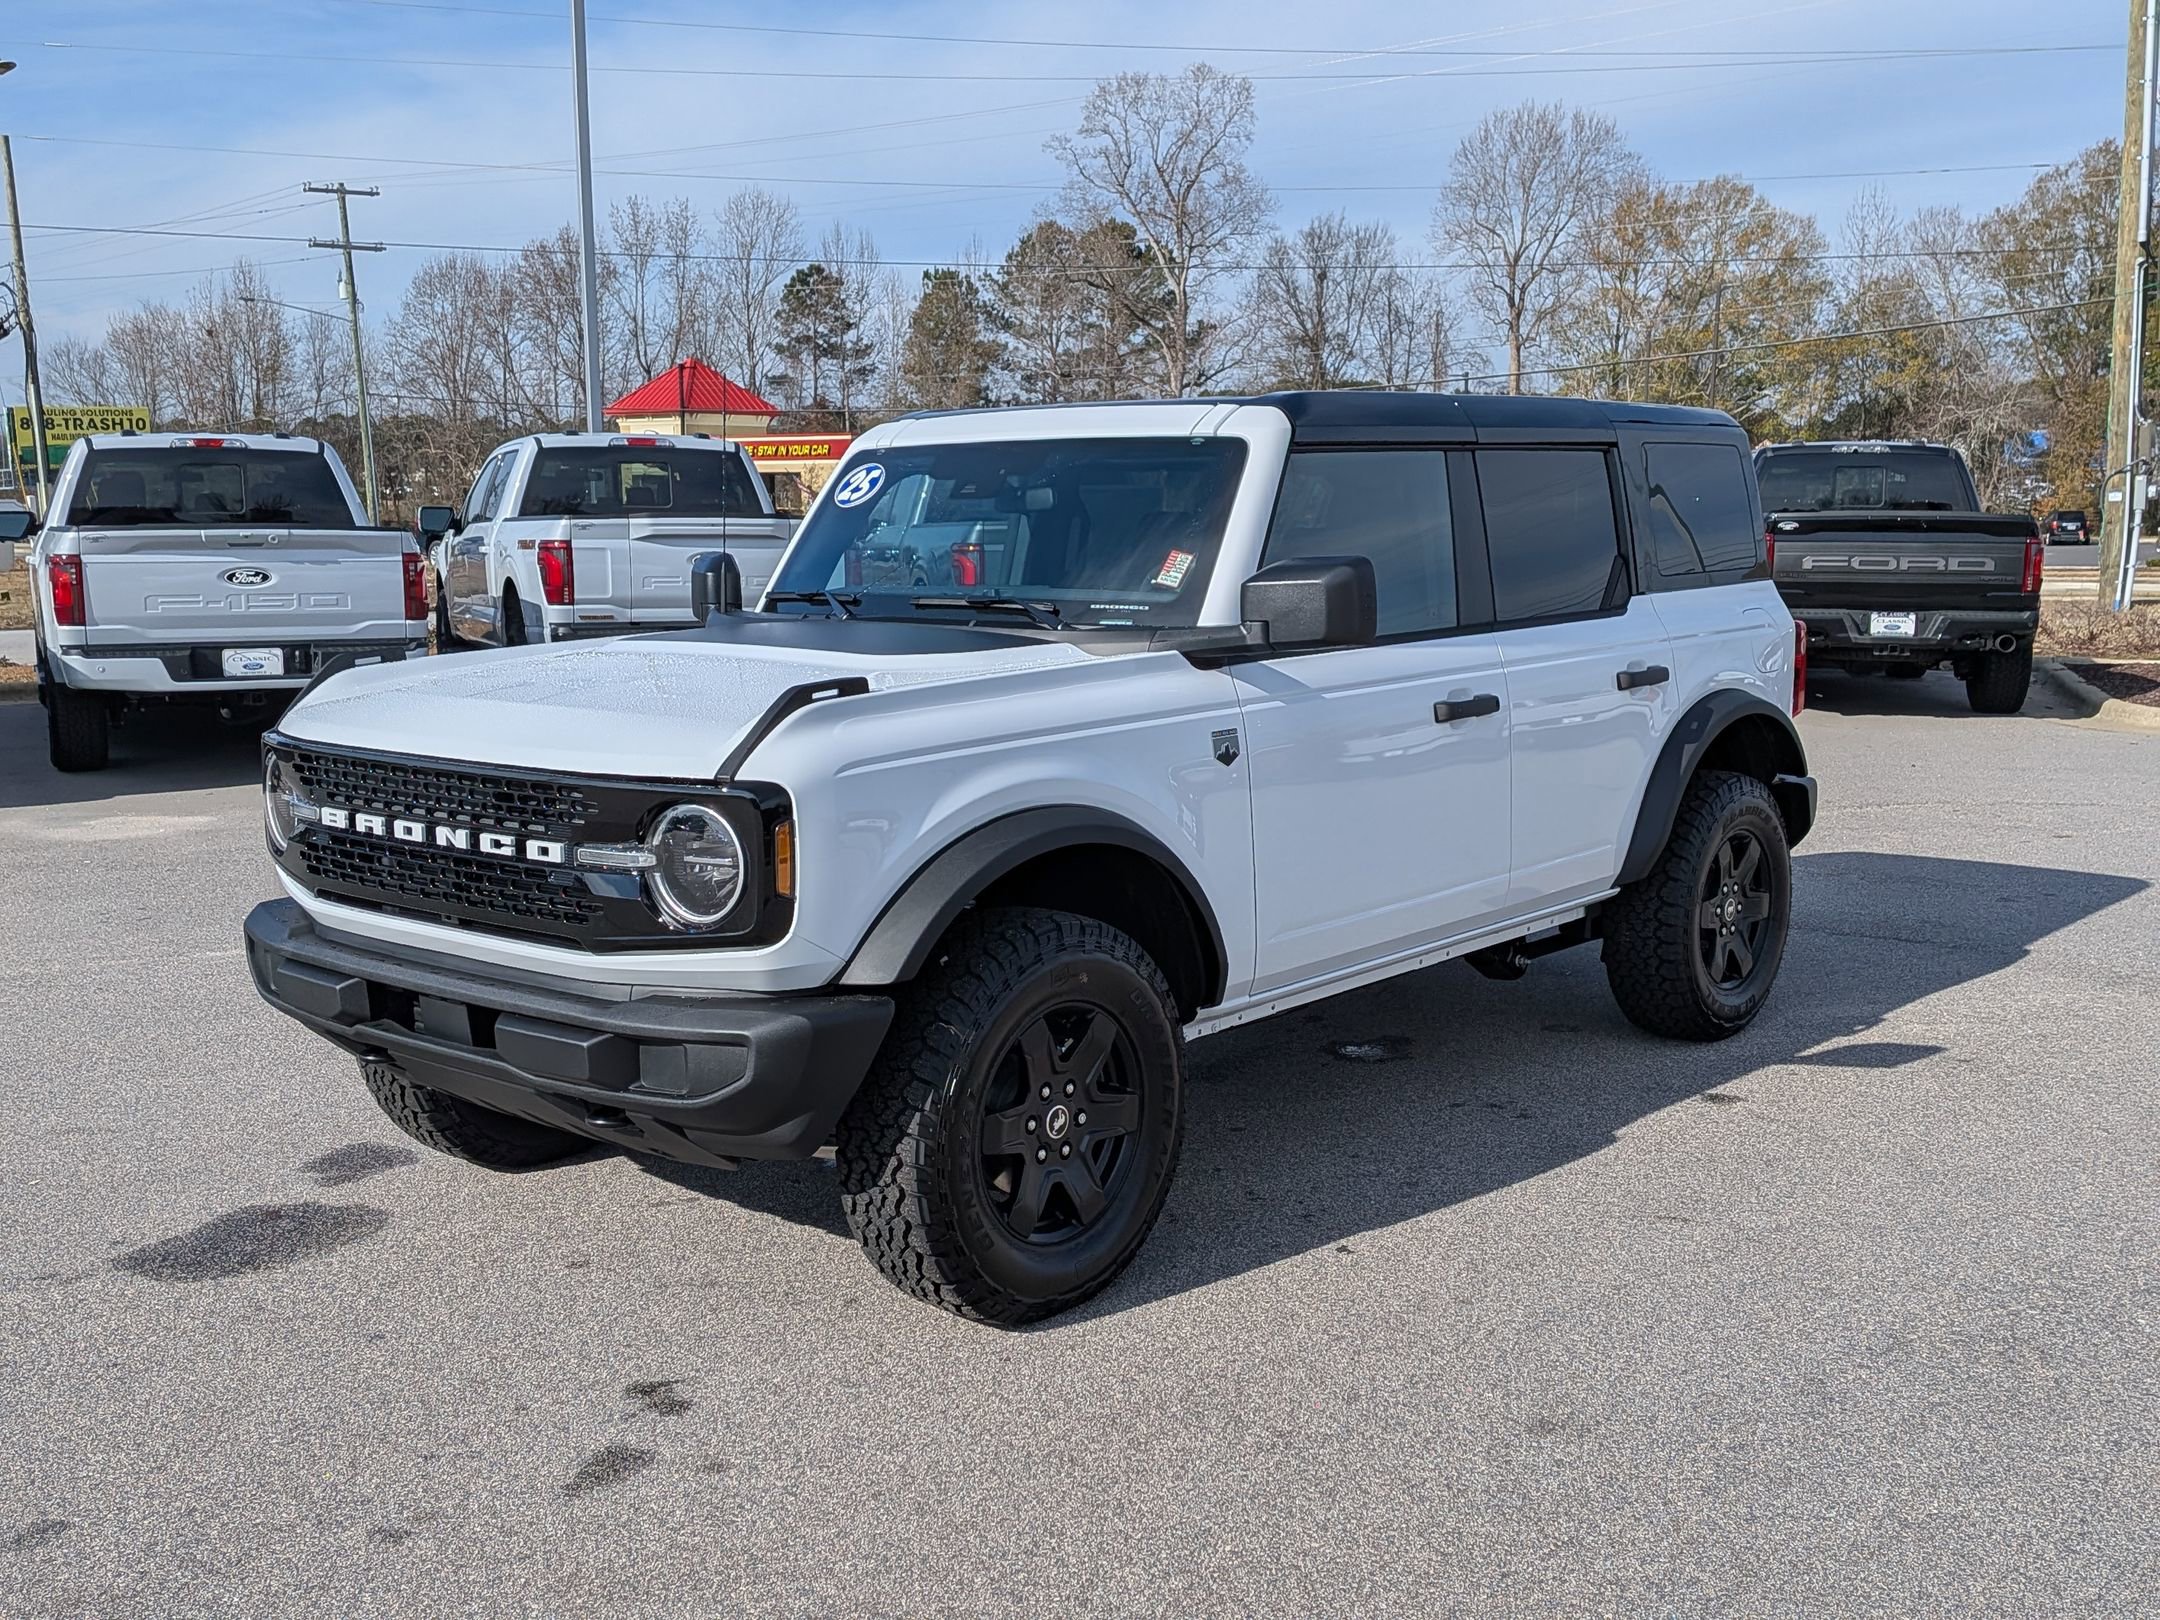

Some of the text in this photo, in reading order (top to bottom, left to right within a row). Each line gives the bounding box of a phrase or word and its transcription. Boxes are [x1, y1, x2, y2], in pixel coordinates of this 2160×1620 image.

[42, 408, 134, 417] AULING SOLUTIONS
[20, 417, 147, 431] 88-TRASH10
[758, 445, 778, 456] STAY
[778, 445, 787, 456] IN
[788, 445, 810, 456] YOUR
[811, 444, 830, 455] CAR
[837, 469, 882, 501] 25
[1802, 555, 1996, 572] FORD
[232, 569, 263, 584] Ford
[144, 592, 352, 613] F-150
[321, 806, 569, 864] BRONCO
